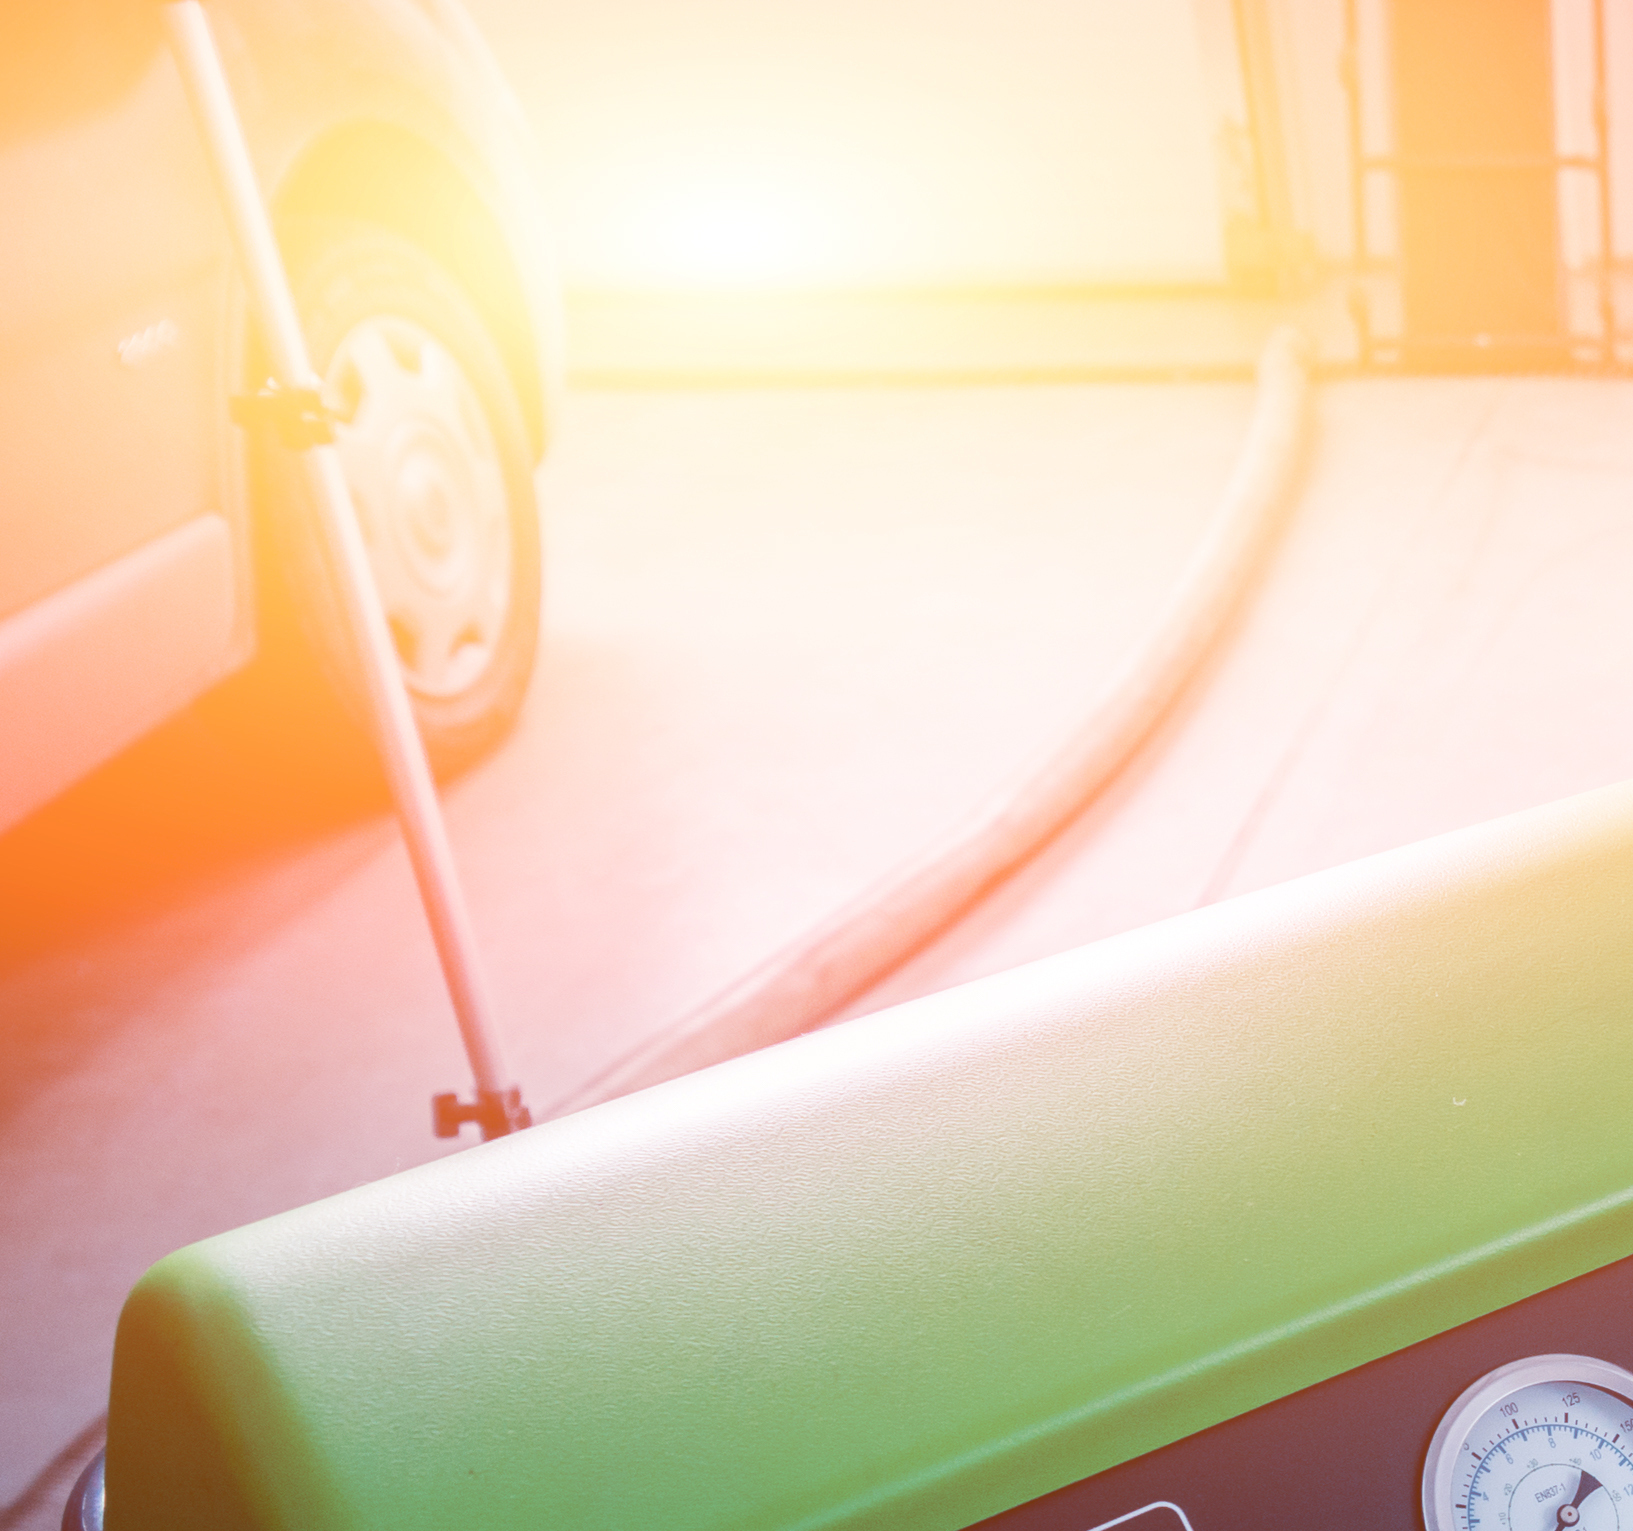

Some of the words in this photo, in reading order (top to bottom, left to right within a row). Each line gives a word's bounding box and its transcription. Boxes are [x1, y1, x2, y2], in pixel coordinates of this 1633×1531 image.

[1562, 1392, 1581, 1407] 125
[1500, 1402, 1519, 1417] 100
[1547, 1438, 1557, 1449] 8
[1505, 1453, 1514, 1465] 6
[1590, 1448, 1602, 1461] 10
[1482, 1491, 1490, 1502] 4
[1534, 1482, 1567, 1503] EN837-1
